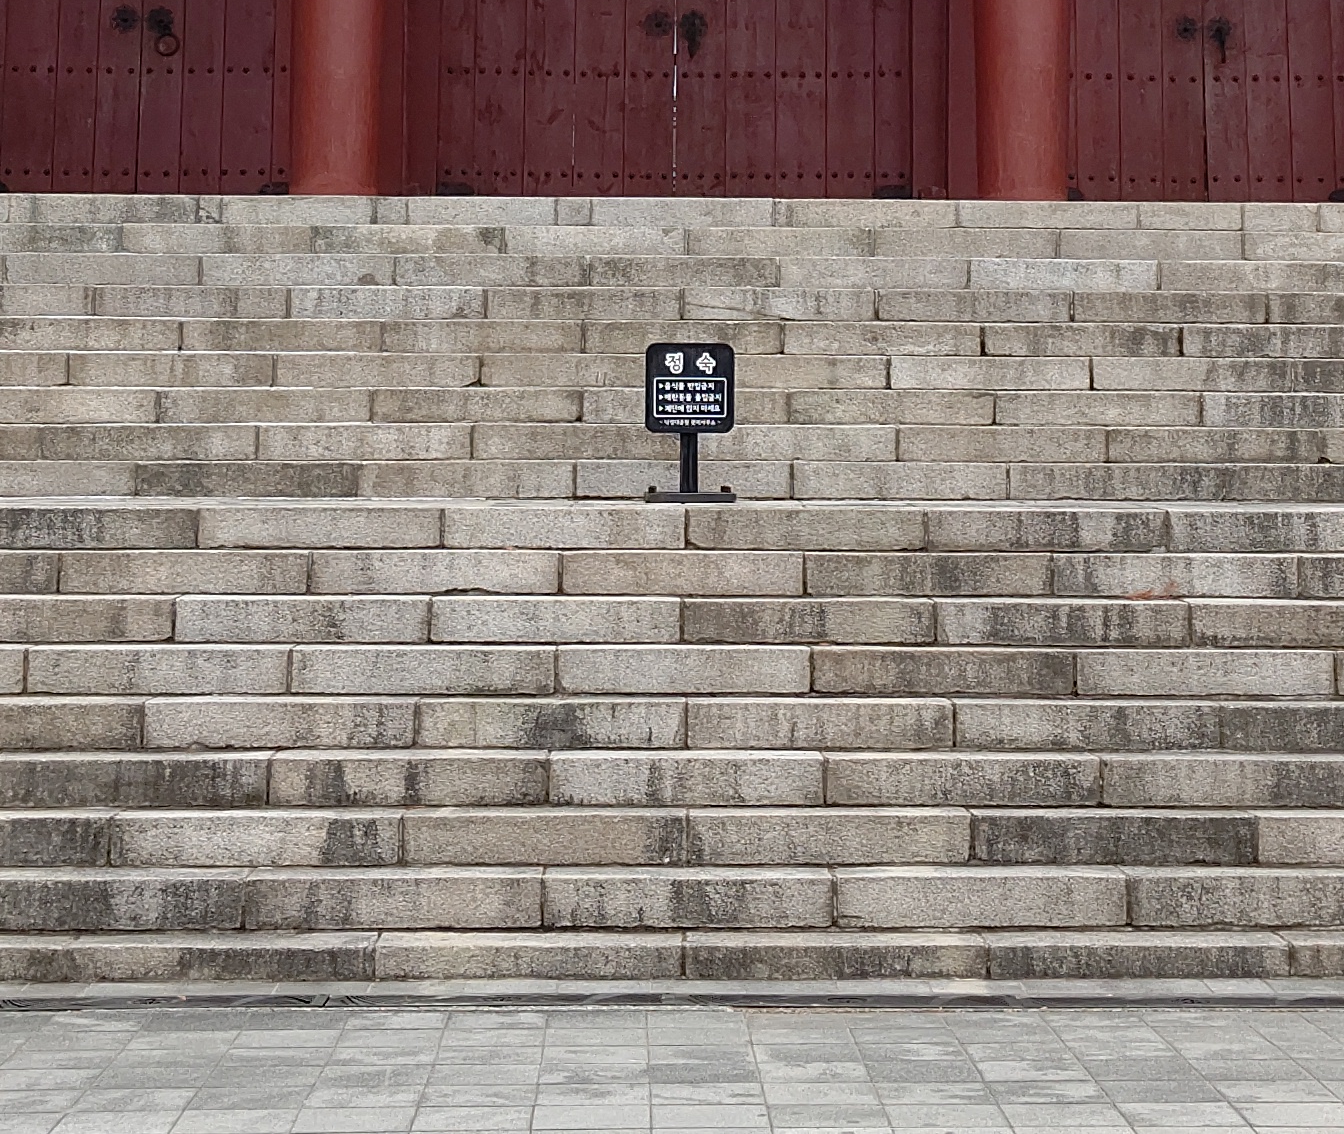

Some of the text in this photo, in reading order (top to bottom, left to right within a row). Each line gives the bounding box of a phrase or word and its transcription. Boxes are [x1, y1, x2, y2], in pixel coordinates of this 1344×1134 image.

[665, 352, 716, 374] 정 숙
[687, 382, 715, 391] 반입금지
[695, 393, 722, 402] 출입금지
